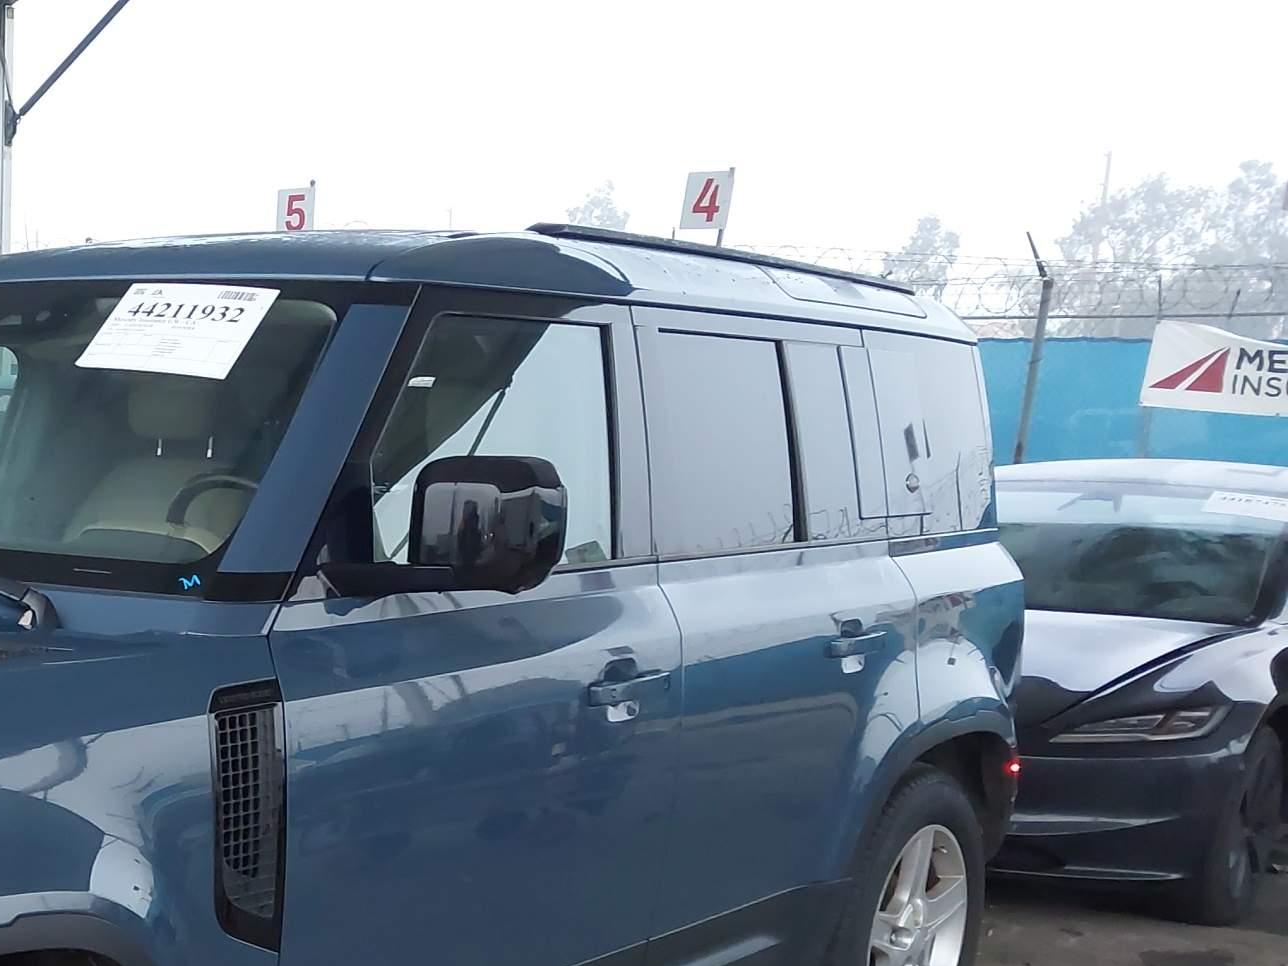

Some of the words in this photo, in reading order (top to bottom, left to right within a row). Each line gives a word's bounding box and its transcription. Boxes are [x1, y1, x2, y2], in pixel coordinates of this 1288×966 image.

[285, 194, 305, 231] 5
[692, 178, 720, 222] 4
[127, 301, 246, 324] 44211932
[1232, 374, 1288, 397] INS
